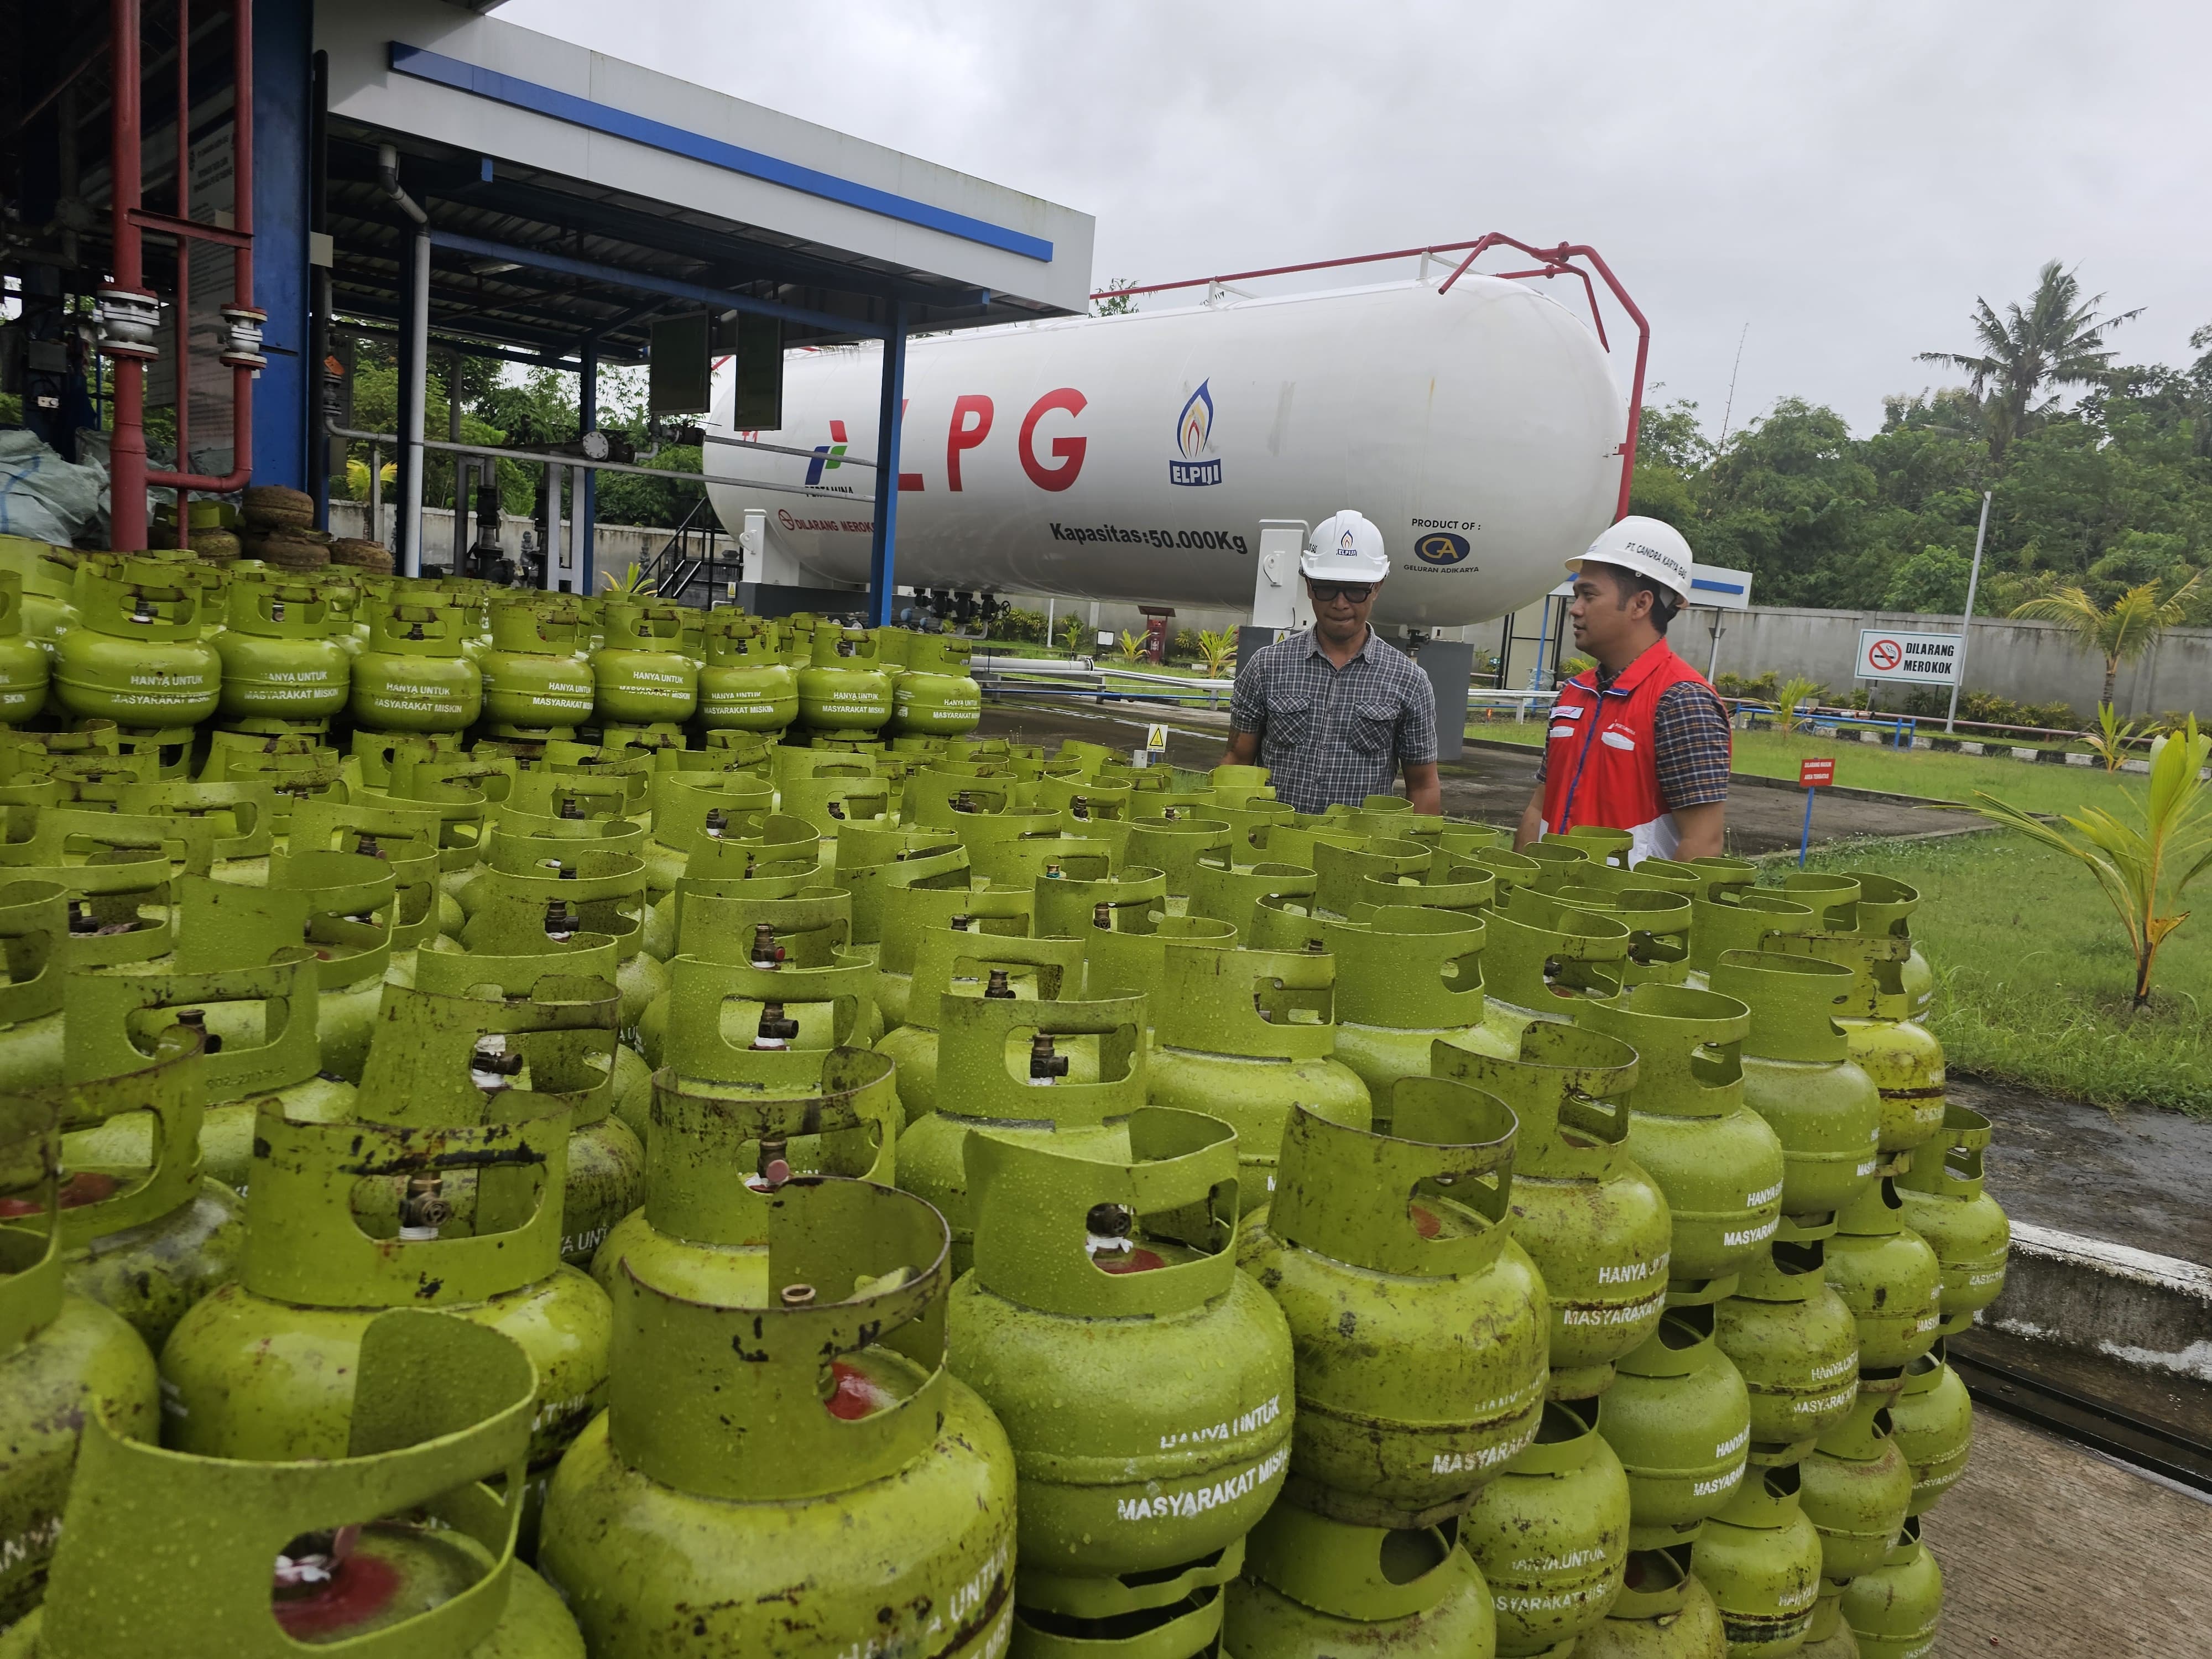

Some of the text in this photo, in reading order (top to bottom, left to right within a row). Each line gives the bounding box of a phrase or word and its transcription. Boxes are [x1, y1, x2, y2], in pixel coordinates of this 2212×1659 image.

[1172, 465, 1219, 484] ELPIJI
[794, 519, 875, 533] DILARANG MEROK
[1412, 518, 1459, 529] PRODUCT
[1636, 545, 1662, 562] CANDRA
[1662, 555, 1679, 573] KARYA
[1404, 565, 1439, 573] GELURAN
[1906, 643, 1954, 656] DILARANG
[1903, 660, 1952, 674] MEROKOK
[131, 675, 203, 687] HANYA UNTUK
[298, 671, 327, 681] UNTUK
[633, 671, 684, 684] HANYA UNTUK
[314, 688, 338, 699] MISKIN
[386, 682, 450, 695] HANYA UNTUK
[549, 682, 574, 692] HANYA
[434, 703, 462, 713] MISKIN
[533, 697, 582, 708] MASYARAKAT
[704, 706, 748, 714] MASYARAKAT
[1747, 1186, 1775, 1207] HANYA
[1599, 1262, 1647, 1284] HANYA
[1811, 1361, 1844, 1381] HANYA
[1716, 1432, 1744, 1458] HANYA
[1118, 1467, 1256, 1521] MASYARAKAT
